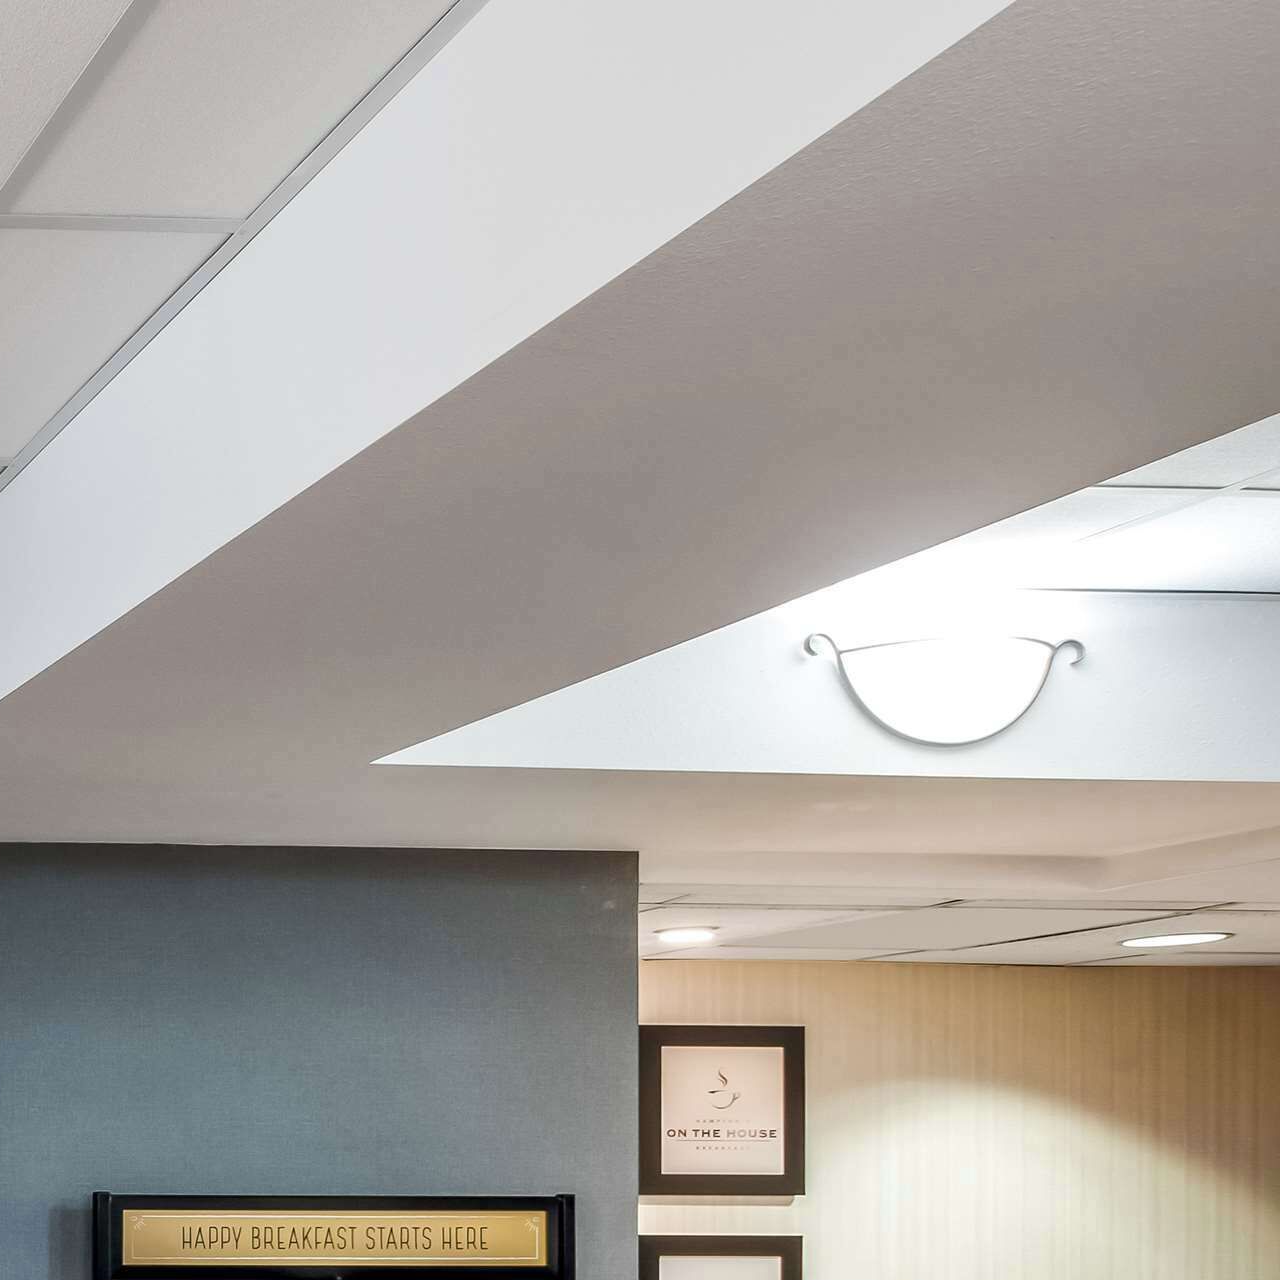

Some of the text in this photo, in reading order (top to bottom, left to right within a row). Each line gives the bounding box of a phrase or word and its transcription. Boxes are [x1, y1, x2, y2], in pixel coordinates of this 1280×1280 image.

[666, 1128, 777, 1138] ON THE HOUSE
[182, 1226, 489, 1250] HAPPY BREAKFAST STARTS HERE
